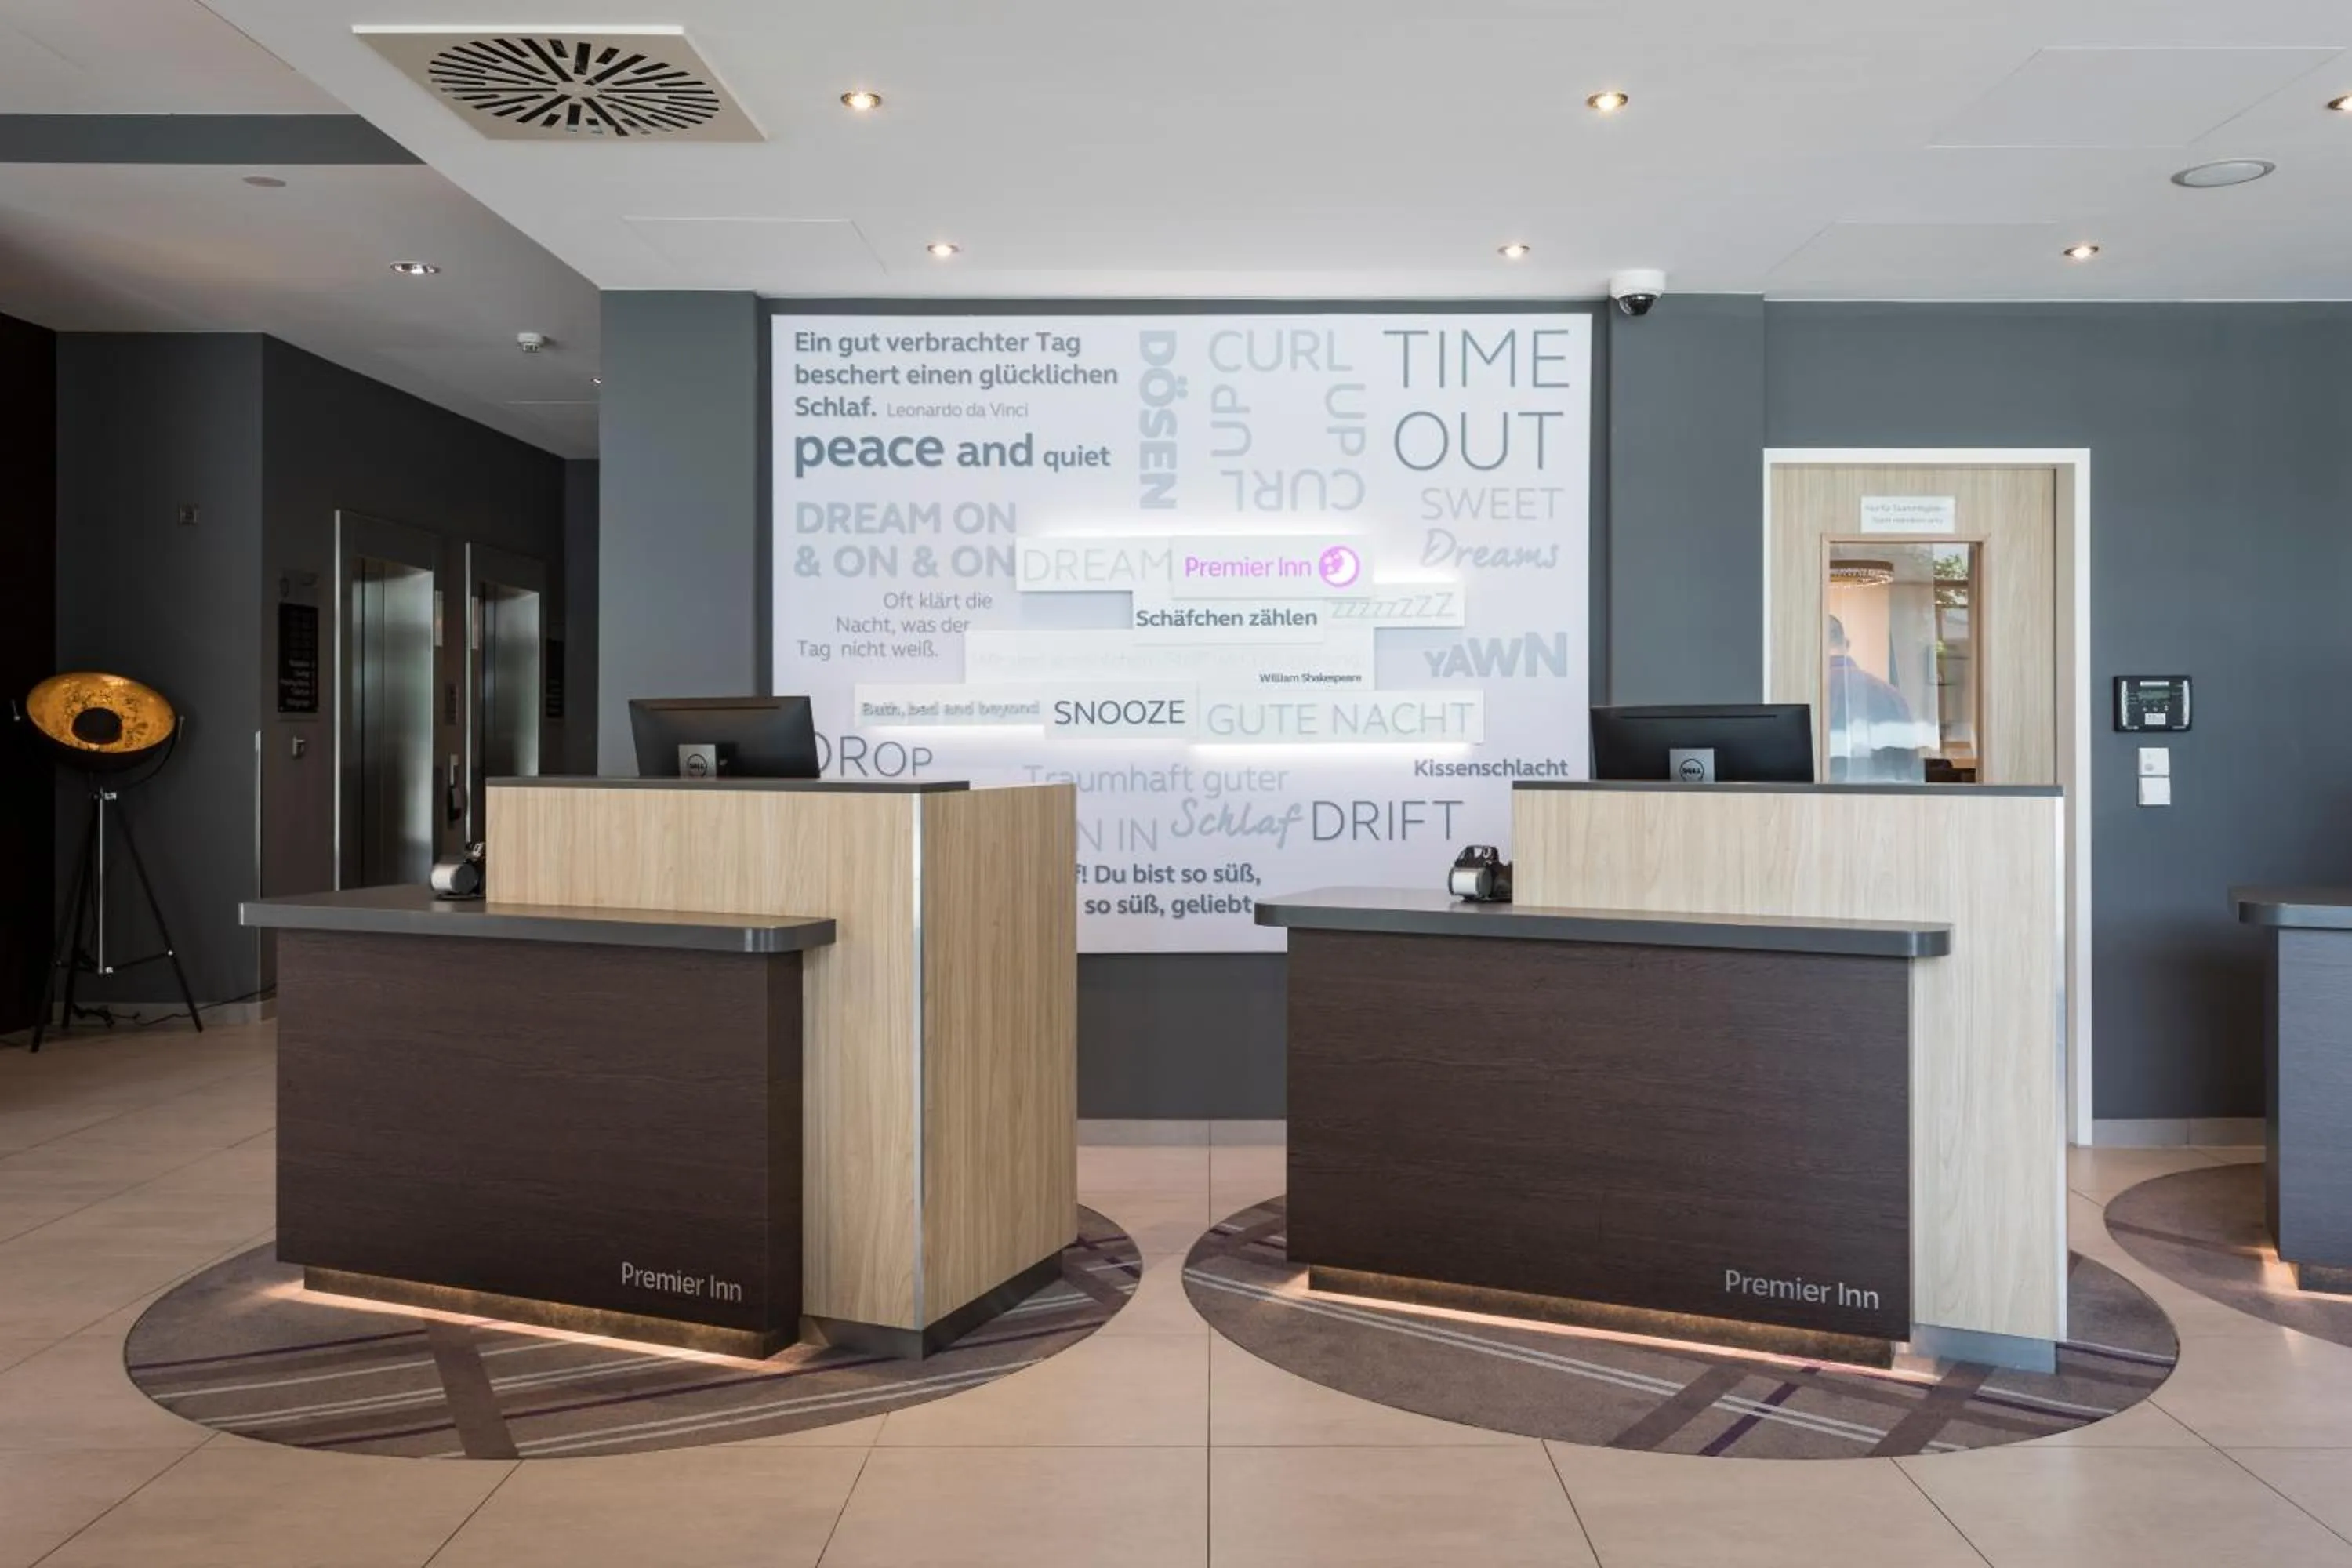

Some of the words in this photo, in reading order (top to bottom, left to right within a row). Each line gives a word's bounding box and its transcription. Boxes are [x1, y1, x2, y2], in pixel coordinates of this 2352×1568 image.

[794, 332, 832, 354] Ein
[838, 332, 880, 358] gut
[886, 332, 1029, 354] verbrachter
[1036, 332, 1081, 358] Tag
[1208, 329, 1354, 373] CURL
[1383, 329, 1569, 388] TIME
[794, 364, 901, 386] beschert
[906, 365, 973, 386] einen
[979, 363, 1119, 390] glücklichen
[794, 395, 877, 418] Schlaf.
[887, 401, 963, 419] Leonardo
[966, 401, 987, 419] da
[991, 401, 1029, 419] Vinci
[1139, 329, 1189, 510] DÖSEN
[1210, 383, 1253, 457] UP
[1324, 383, 1366, 457] UP
[794, 434, 945, 479] peace
[956, 433, 1033, 468] and
[1044, 445, 1112, 472] quiet
[1394, 411, 1564, 471] OUT
[1220, 469, 1366, 512] CURL
[1421, 487, 1565, 521] SWEET
[796, 501, 942, 535] DREAM
[953, 501, 1016, 535] ON
[794, 545, 821, 578] &
[833, 545, 898, 578] ON
[912, 545, 938, 578] &
[951, 545, 1016, 578] ON
[1419, 528, 1559, 569] Dreams
[1022, 549, 1173, 583] DREAM
[1185, 555, 1270, 579] Premier
[1279, 556, 1312, 578] Inn
[883, 592, 913, 610] Oft
[919, 591, 961, 610] klärt
[965, 591, 993, 610] die
[836, 616, 897, 636] Nacht,
[901, 621, 937, 634] was
[941, 616, 971, 634] der
[1136, 608, 1243, 628] Schäfchen
[1249, 608, 1318, 628] zählen
[797, 640, 831, 662] Tag
[841, 639, 887, 658] nicht
[892, 639, 939, 658] weiß.
[1054, 700, 1186, 724] SNOOZE
[1207, 702, 1318, 736] GUTE
[1334, 702, 1474, 735] NACHT
[1202, 766, 1290, 798] guter
[1414, 758, 1569, 779] Kissenschlacht
[1118, 818, 1157, 852] IN
[1171, 797, 1304, 850] Schlaf
[1312, 800, 1465, 842] DRIFT
[1094, 864, 1126, 884] Du
[1133, 863, 1176, 884] bist
[1181, 868, 1207, 884] so
[1213, 862, 1261, 887] süß,
[1084, 899, 1112, 915] so
[1117, 894, 1165, 918] süß,
[1171, 893, 1253, 919] geliebt
[622, 1261, 705, 1297] Premier
[710, 1274, 742, 1302] Inn
[1726, 1269, 1831, 1304] Premier
[1838, 1282, 1879, 1310] Inn
